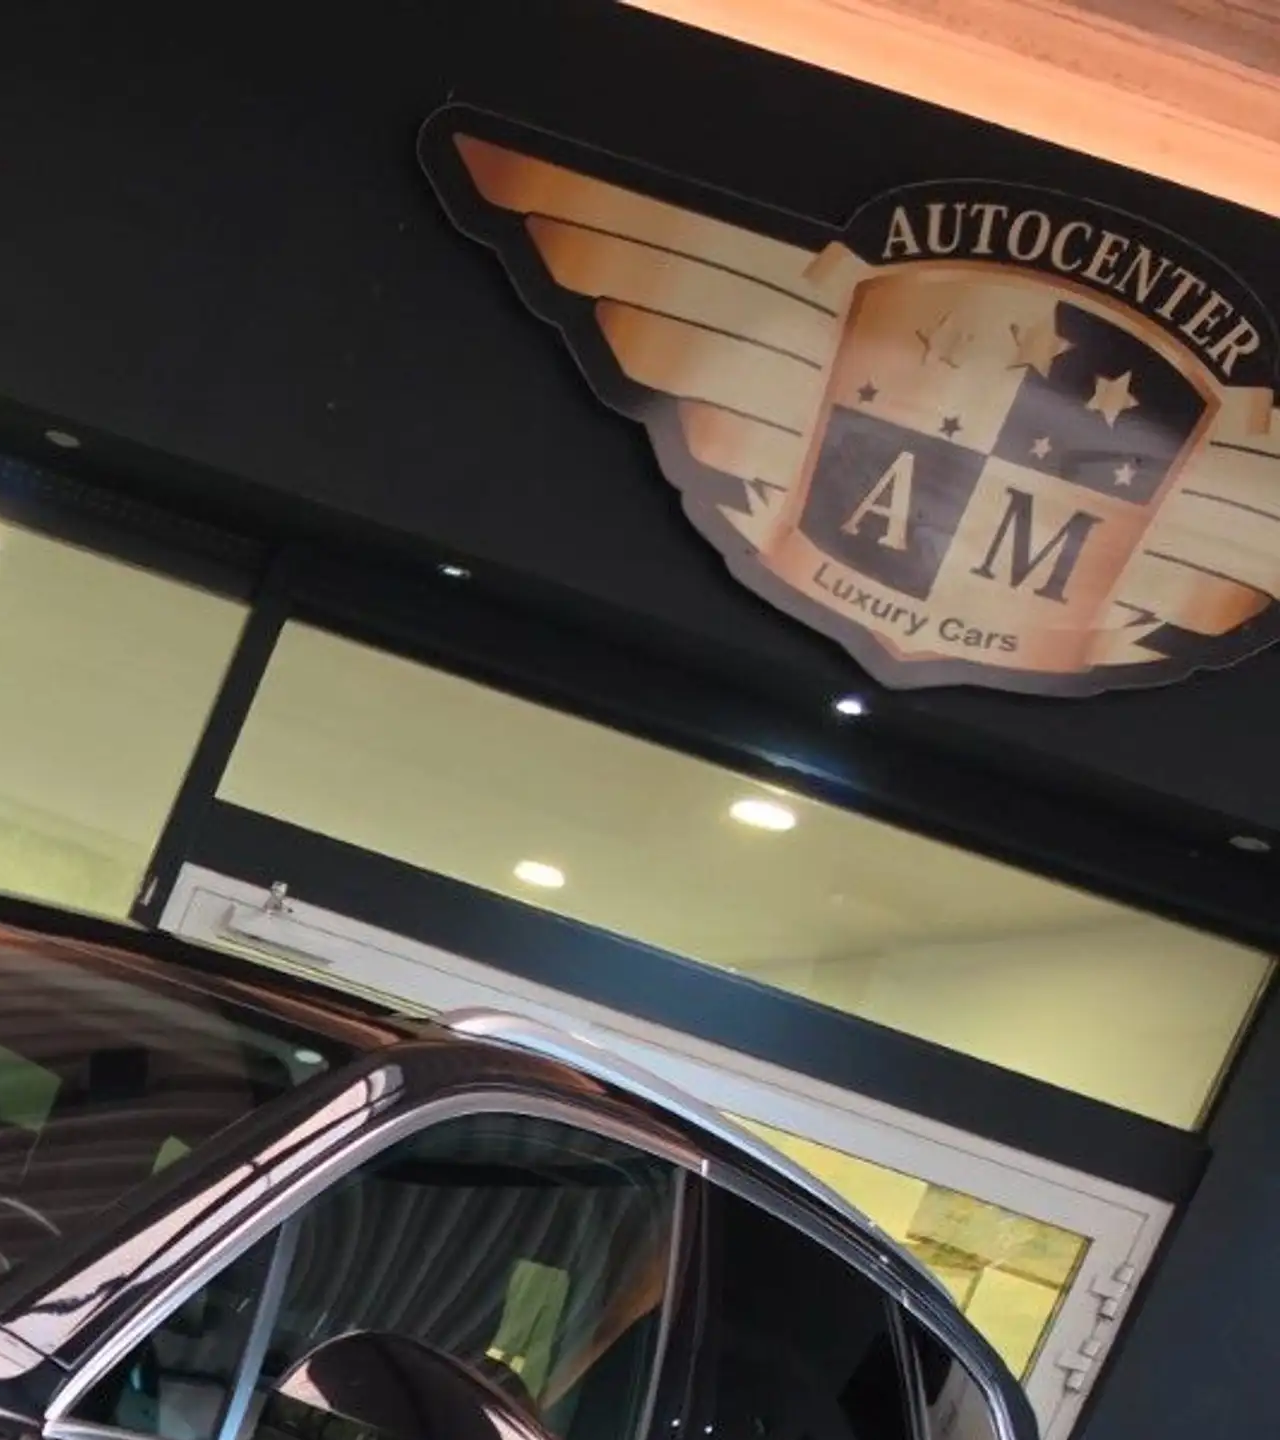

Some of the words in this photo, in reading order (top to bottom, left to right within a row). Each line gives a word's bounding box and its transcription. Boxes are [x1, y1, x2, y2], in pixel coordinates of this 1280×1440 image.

[882, 202, 1262, 377] AUTOCENTER
[840, 451, 919, 552] A
[971, 487, 1103, 604] M
[812, 562, 930, 637] Luxury
[938, 615, 1019, 653] Cars
